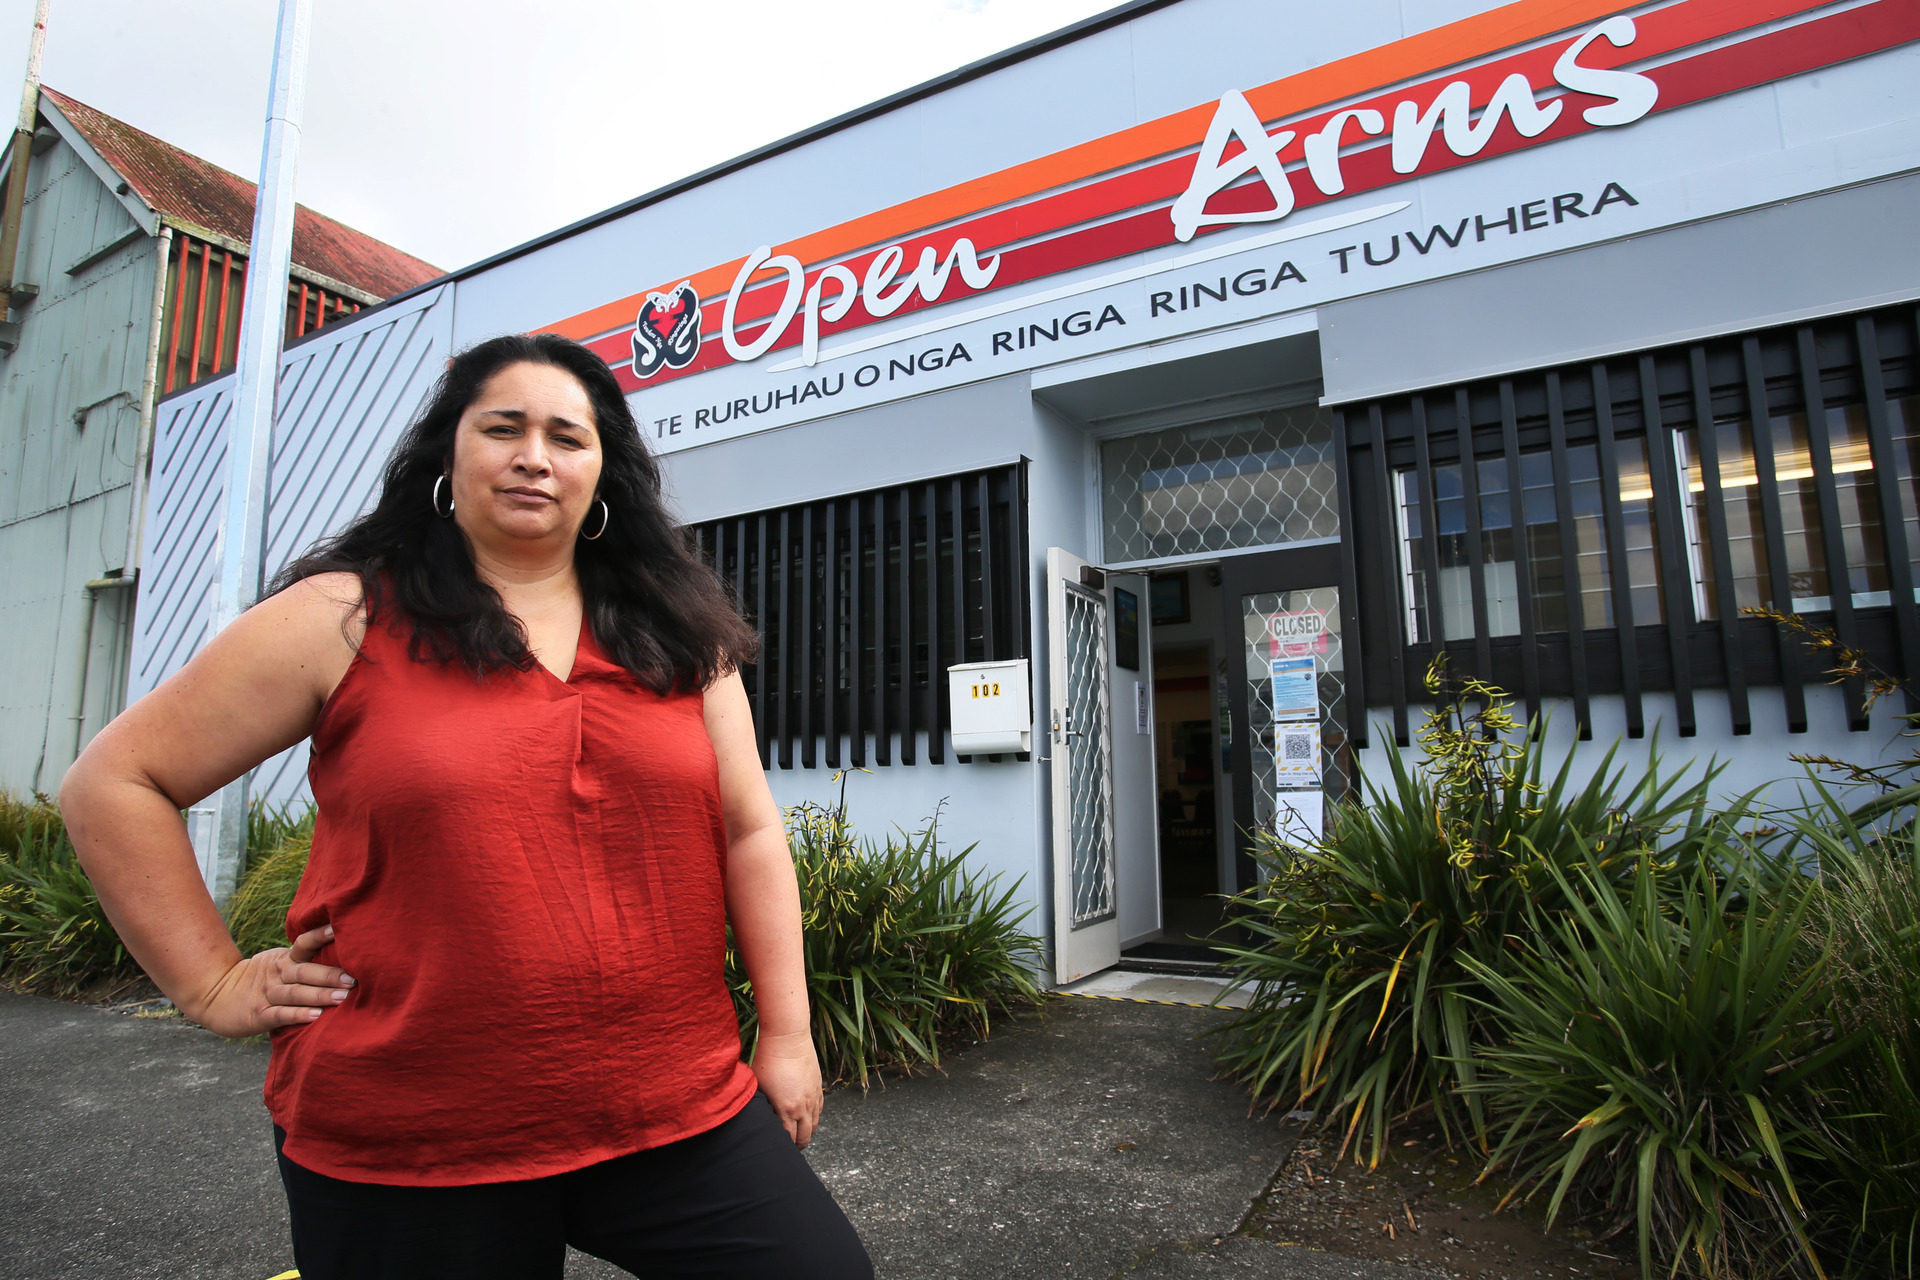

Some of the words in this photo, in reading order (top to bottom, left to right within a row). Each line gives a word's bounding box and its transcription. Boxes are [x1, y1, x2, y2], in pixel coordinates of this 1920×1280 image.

[722, 245, 1000, 367] Open
[1170, 15, 1659, 243] Arms
[654, 414, 682, 438] TE
[694, 372, 844, 429] RURUHAU
[854, 364, 880, 388] O
[889, 342, 973, 381] NGA
[992, 304, 1126, 356] RINGA
[1150, 261, 1308, 317] RINGA
[1329, 182, 1640, 274] TUWHERA
[972, 683, 999, 698] 102
[1274, 615, 1321, 637] CLOSED
